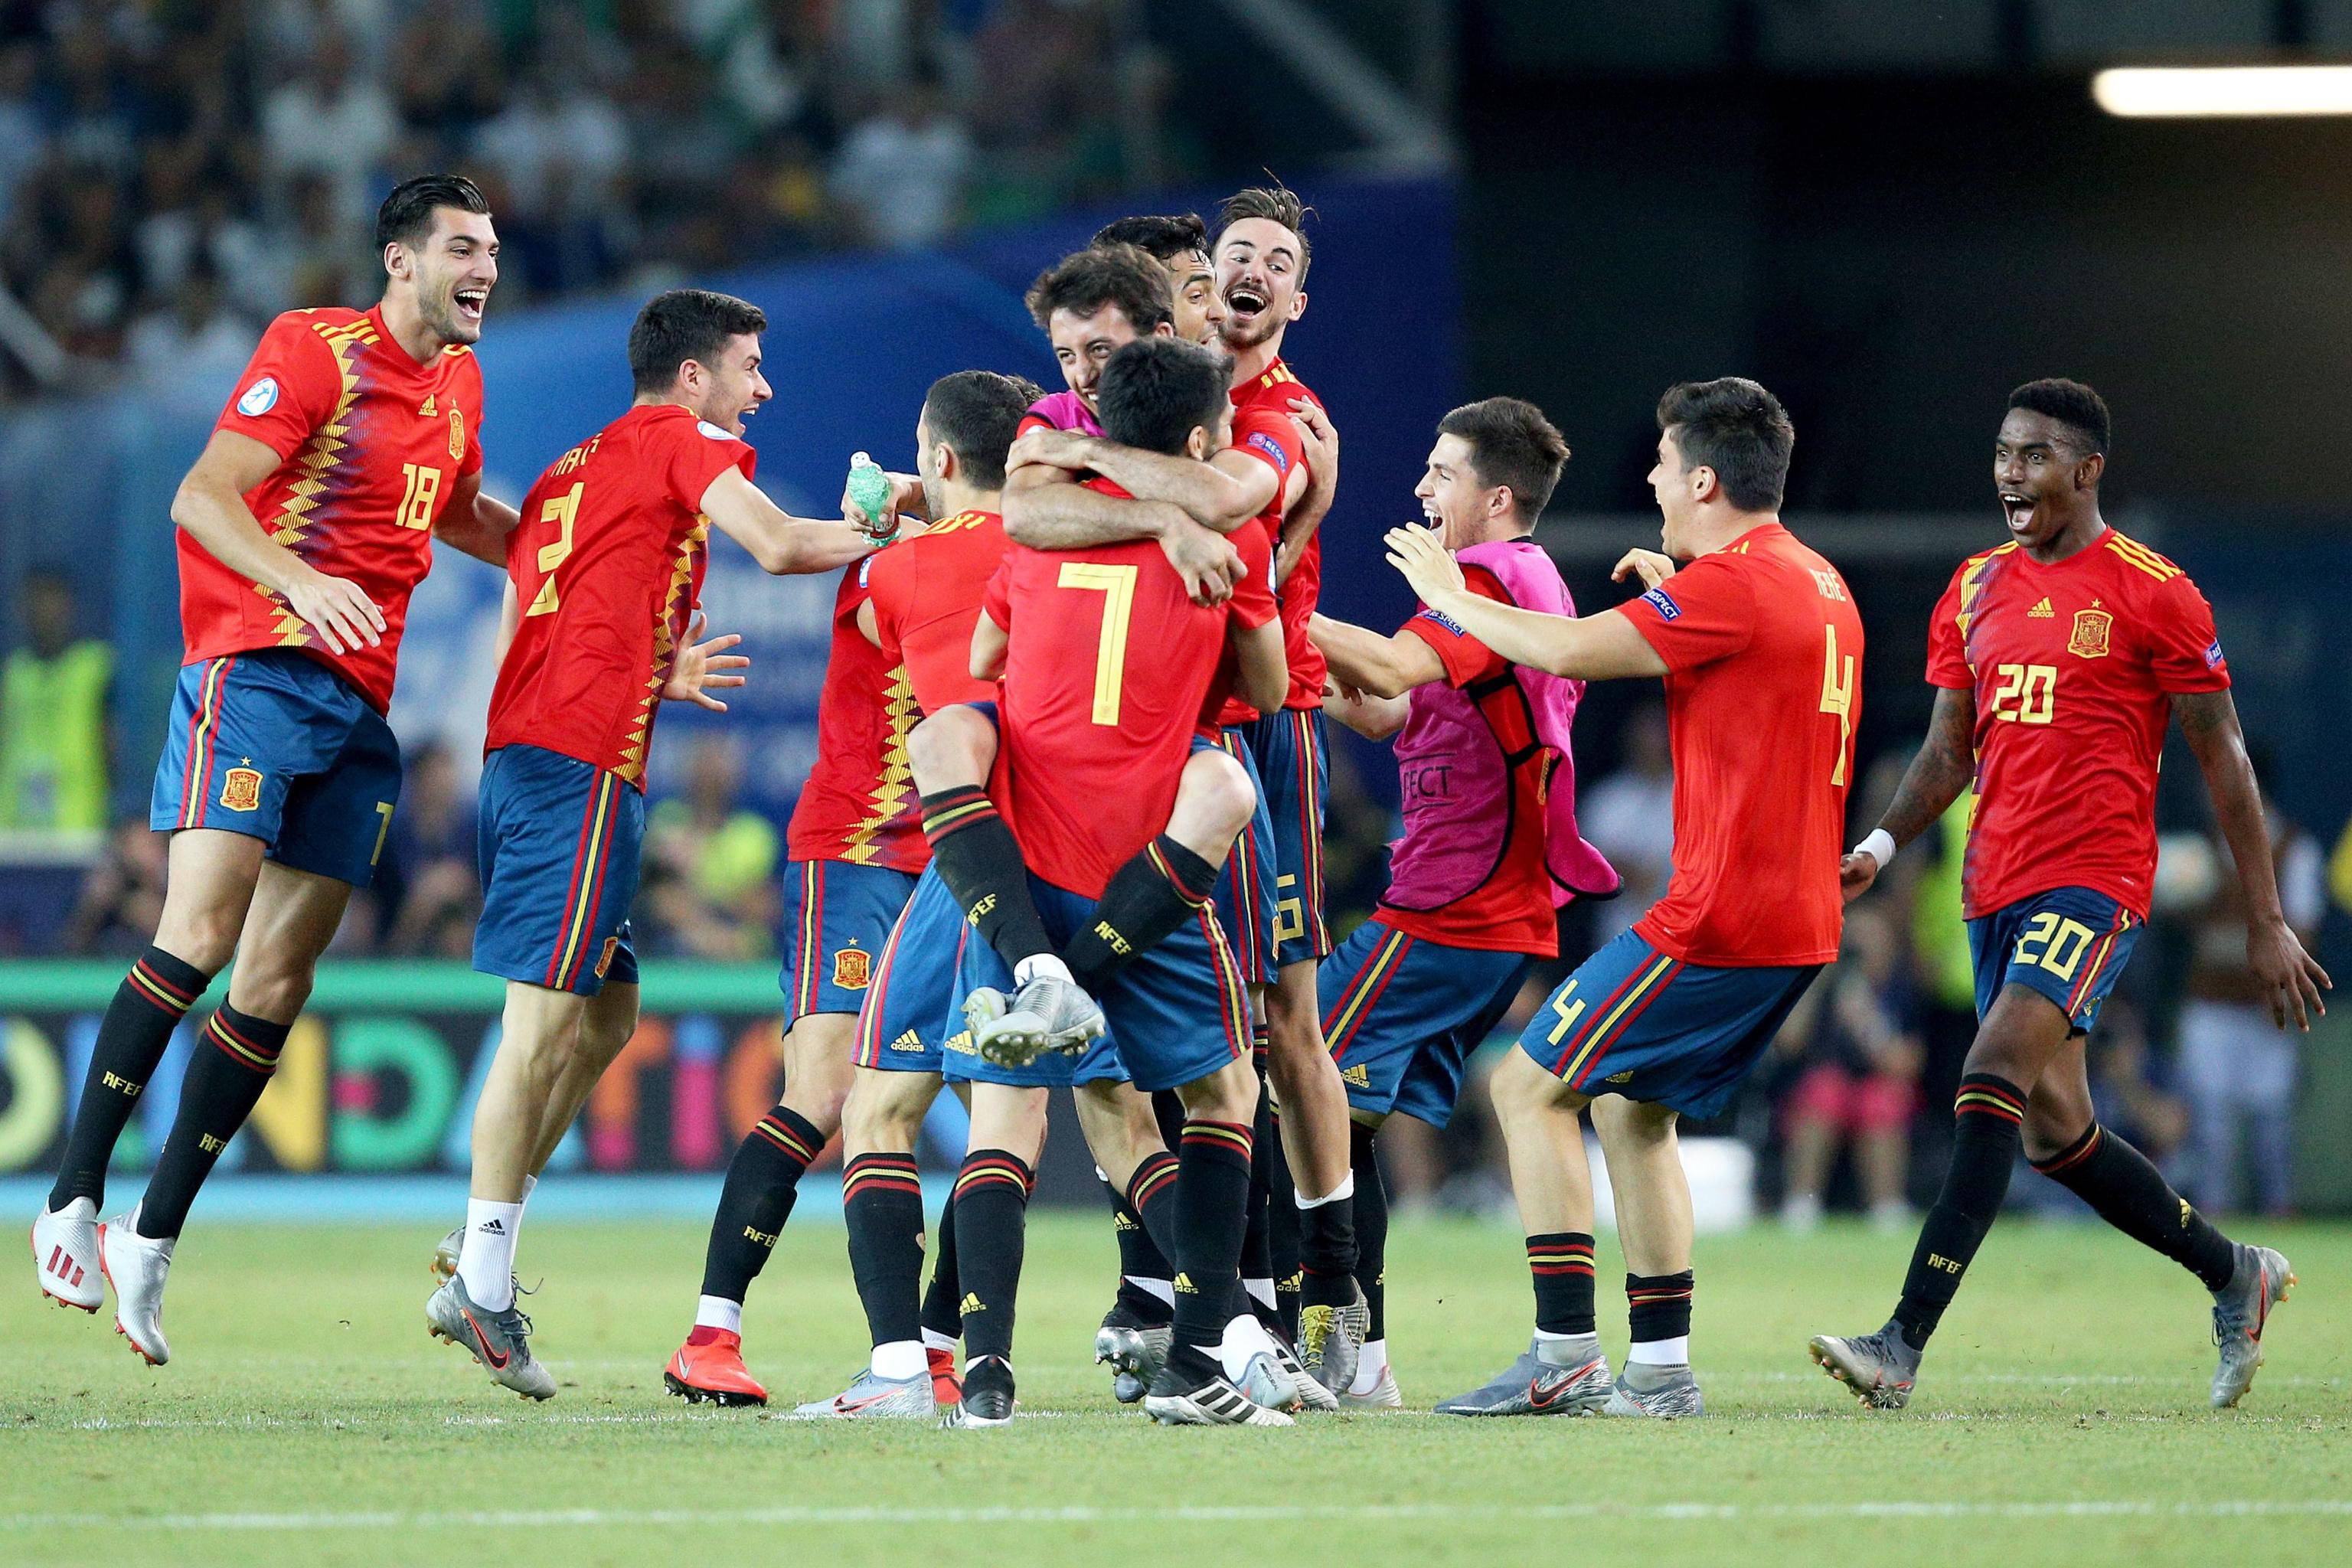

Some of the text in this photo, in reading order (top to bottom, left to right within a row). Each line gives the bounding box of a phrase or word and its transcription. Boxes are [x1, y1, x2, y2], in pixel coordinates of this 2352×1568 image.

[394, 462, 442, 531] 18
[521, 482, 585, 616] 2
[1056, 561, 1138, 727] 7
[2027, 609, 2056, 618] adidas
[1818, 624, 1854, 786] 4
[1991, 663, 2057, 724] 20
[2017, 911, 2094, 982] 20
[890, 1041, 925, 1052] adidas
[1546, 978, 1586, 1047] 4
[944, 1040, 978, 1056] adidas
[478, 1226, 506, 1236] adidas
